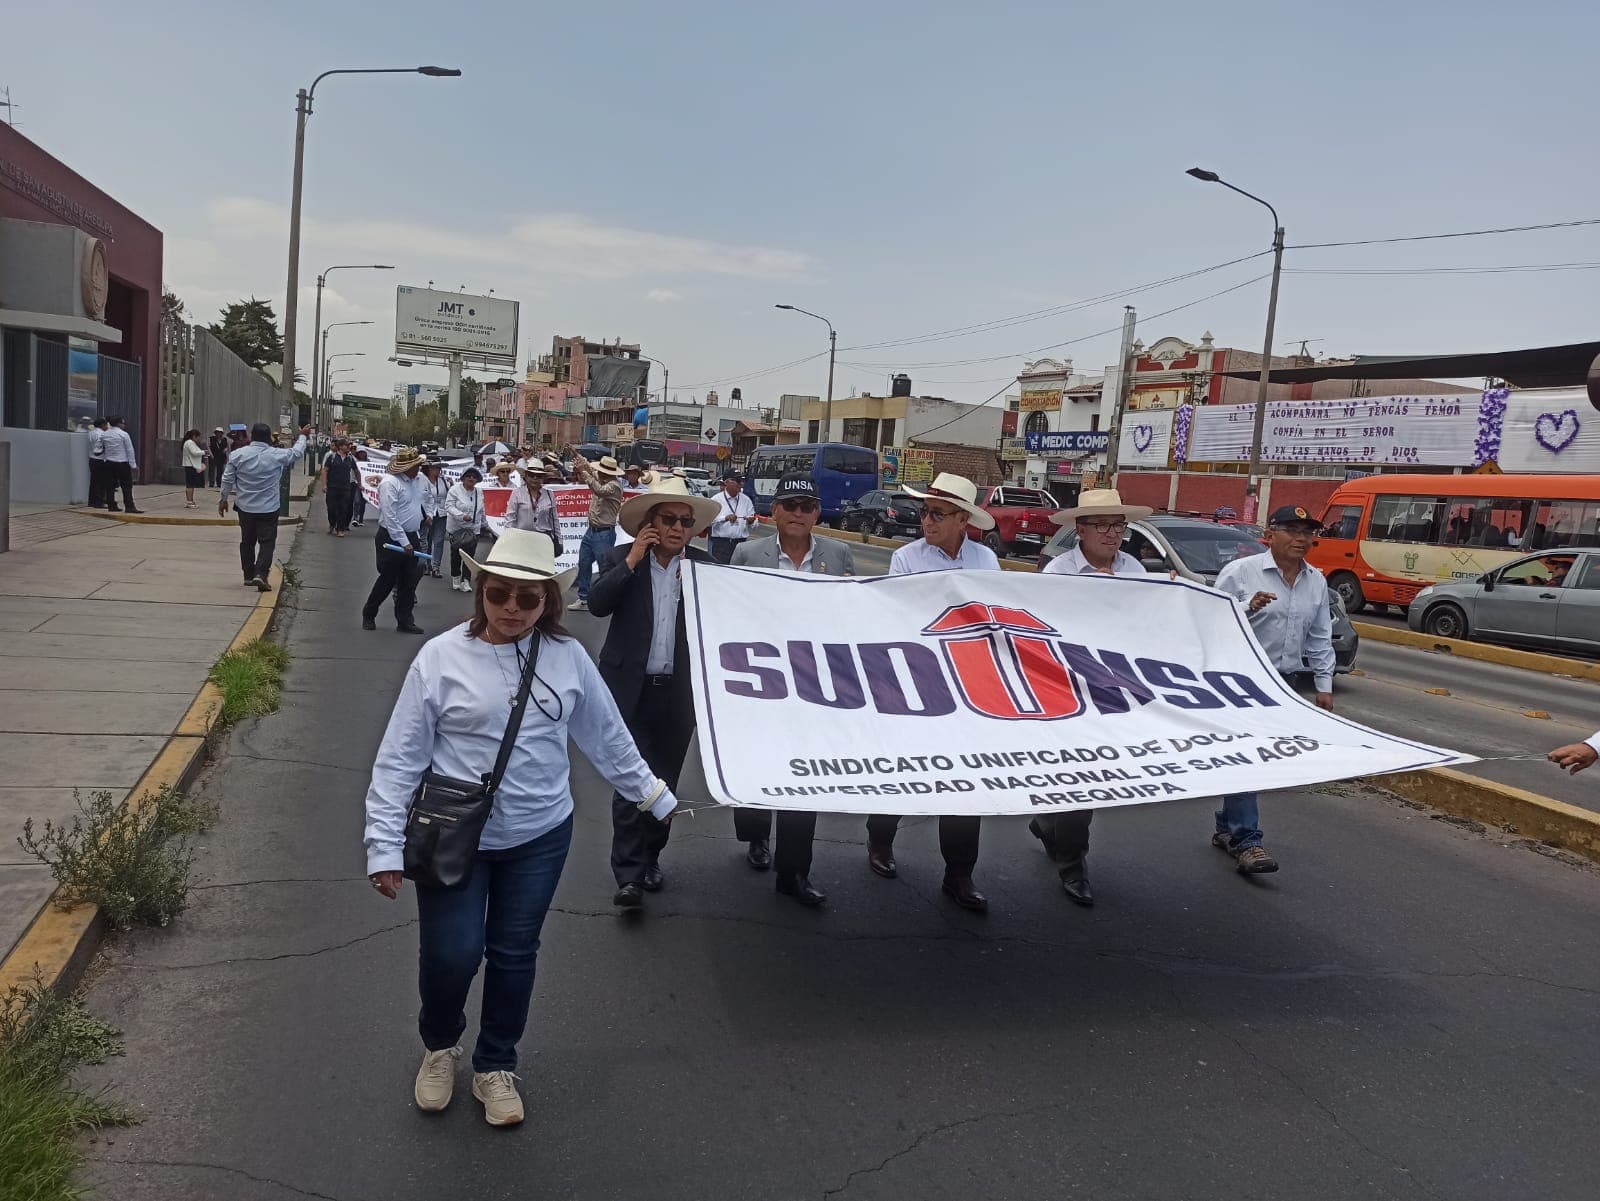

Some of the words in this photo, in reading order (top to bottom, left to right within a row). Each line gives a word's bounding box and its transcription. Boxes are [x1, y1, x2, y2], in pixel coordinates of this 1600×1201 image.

[437, 302, 464, 315] JMT
[1343, 407, 1355, 417] NO
[1424, 405, 1461, 416] TEMOR
[1314, 428, 1326, 437] EN
[1336, 428, 1347, 437] EL
[1042, 435, 1073, 448] MEDIC
[1275, 446, 1287, 455] EN
[1292, 447, 1310, 455] LAS
[1392, 447, 1418, 457] DIOS
[784, 480, 813, 491] UNSA
[789, 755, 954, 777] SINDICATO
[959, 745, 1121, 769] UNIFICADO
[1126, 739, 1167, 758] DE
[760, 778, 977, 797] UNIVERSIDAD
[981, 767, 1143, 791] NACIONAL
[1142, 762, 1188, 778] DE
[1187, 752, 1253, 771] SAN
[1028, 782, 1187, 806] AREQUIPA
